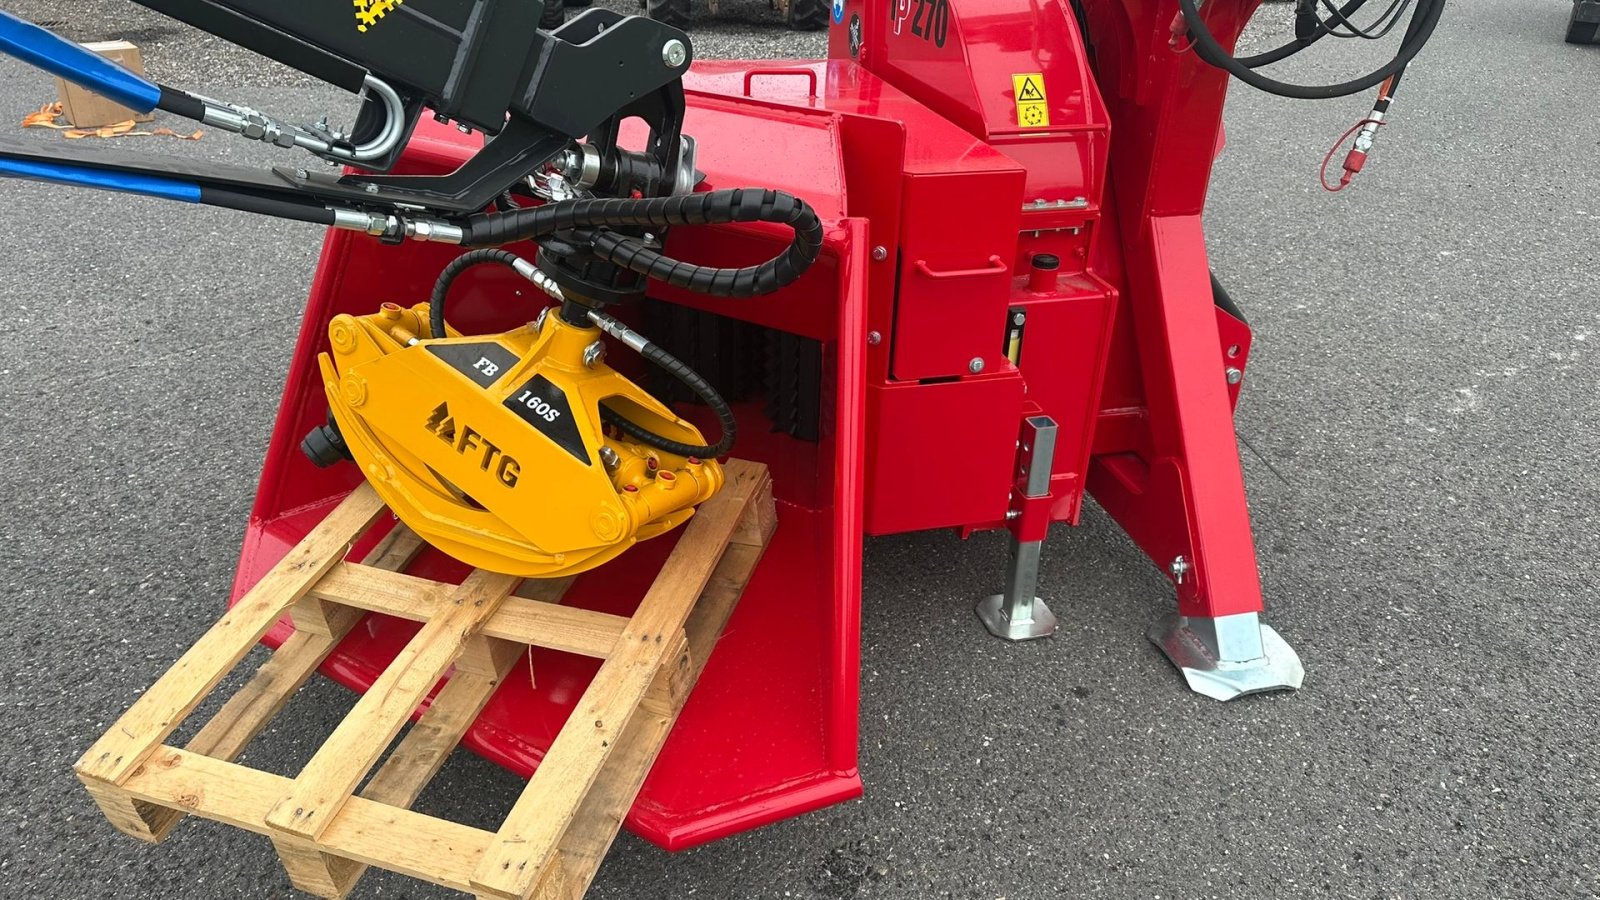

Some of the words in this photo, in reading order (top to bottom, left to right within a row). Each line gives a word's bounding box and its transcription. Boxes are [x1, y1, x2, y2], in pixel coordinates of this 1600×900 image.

[911, 0, 948, 48] 270
[473, 357, 499, 376] FB
[517, 390, 560, 422] 160S
[457, 425, 520, 488] FTG
